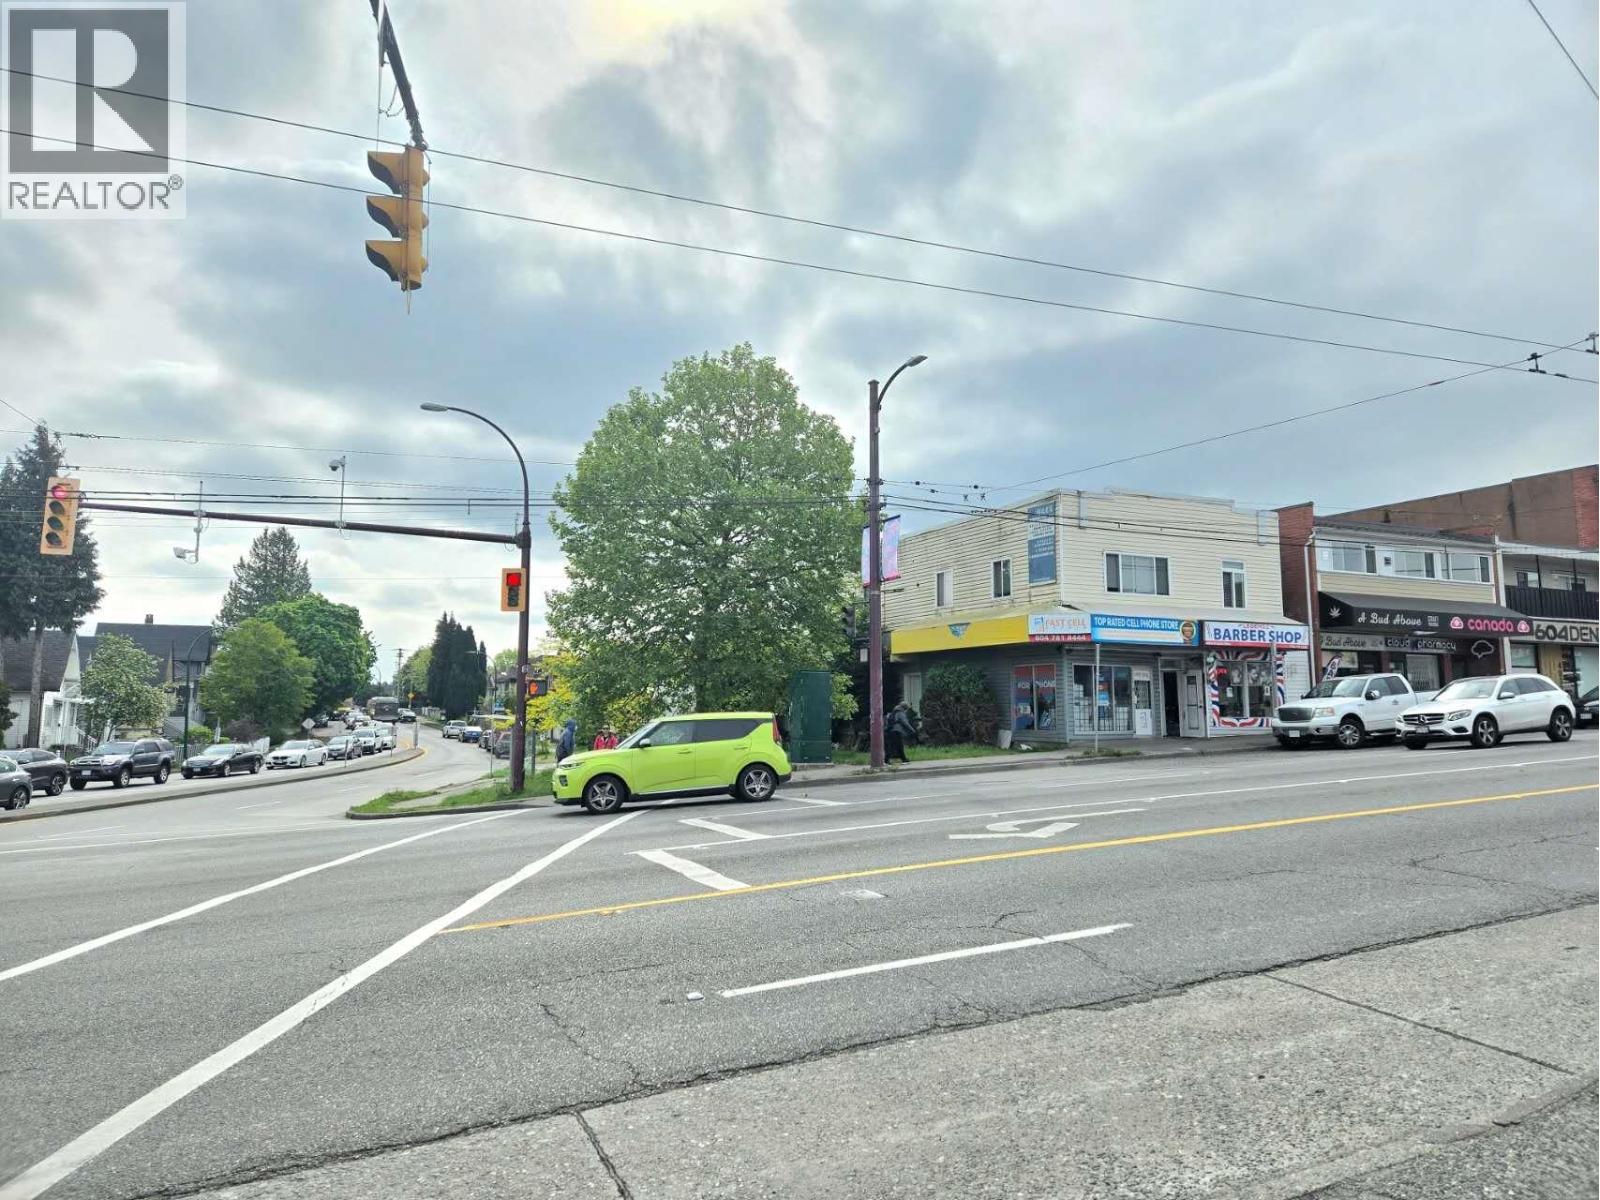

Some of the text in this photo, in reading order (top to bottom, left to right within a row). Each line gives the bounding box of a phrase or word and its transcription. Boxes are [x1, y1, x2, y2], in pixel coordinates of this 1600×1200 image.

[1094, 616, 1179, 630] TOP RATED CELL PHONE STORE
[1370, 612, 1390, 625] Bud
[1393, 614, 1422, 626] Above
[1467, 618, 1514, 632] canada
[1213, 628, 1302, 644] BARBER SHOP
[1417, 640, 1457, 651] pharmacy
